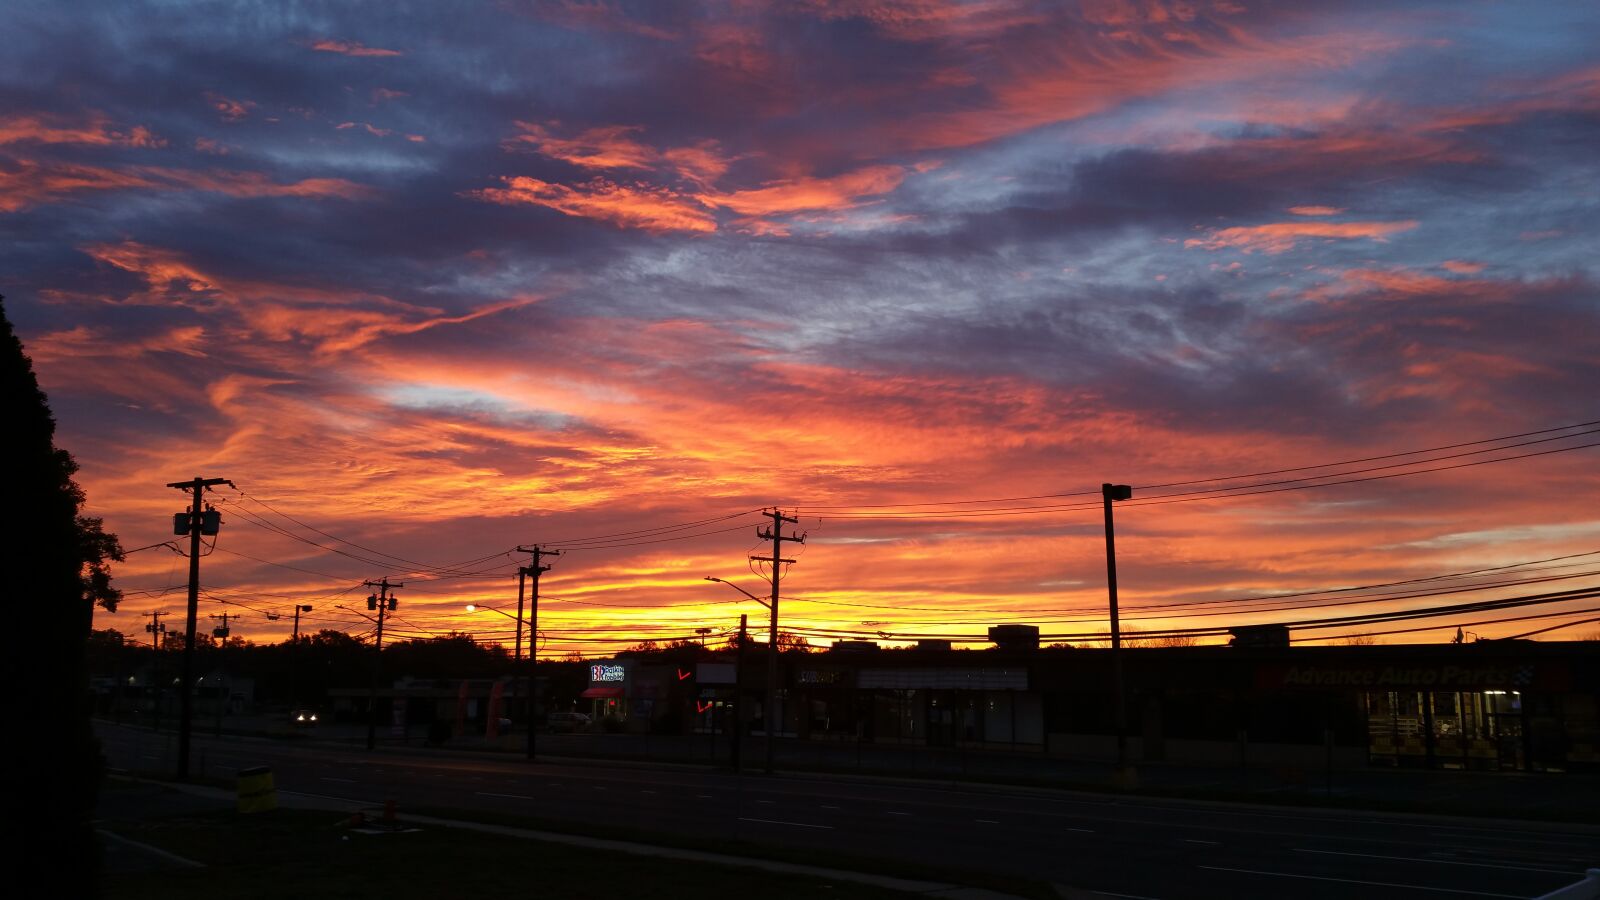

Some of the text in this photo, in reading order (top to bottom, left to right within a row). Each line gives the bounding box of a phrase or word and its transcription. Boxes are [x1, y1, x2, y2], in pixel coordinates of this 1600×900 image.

[1283, 665, 1507, 685] Advance Auto Parts
